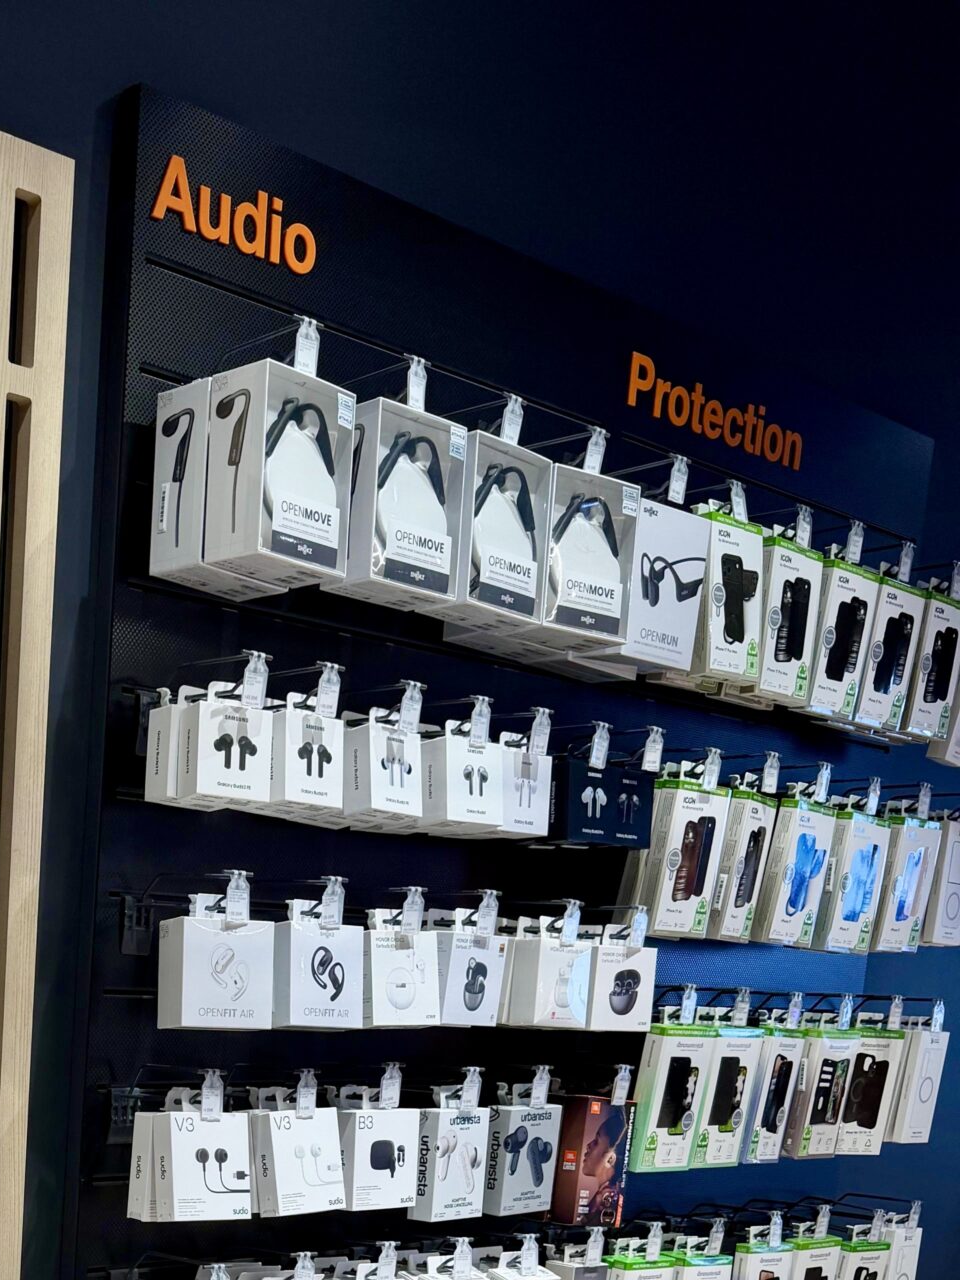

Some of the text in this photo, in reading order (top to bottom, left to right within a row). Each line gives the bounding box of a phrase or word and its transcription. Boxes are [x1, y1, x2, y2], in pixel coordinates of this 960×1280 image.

[151, 155, 316, 275] Audio
[628, 351, 803, 472] Protection
[281, 500, 332, 527] OPENMOVE
[395, 529, 444, 554] OPENMOVE
[488, 555, 532, 579] OPENMOVE
[566, 578, 615, 600] OPENMOVE
[640, 627, 679, 648] OPENRUN
[198, 1007, 255, 1019] OPENFIT AIR
[303, 1007, 349, 1018] OPENFIT AIR
[174, 1116, 195, 1132] V3
[273, 1115, 292, 1130] V3
[358, 1115, 374, 1130] B3
[450, 1115, 481, 1126] urbanista
[521, 1111, 552, 1122] urbanista
[417, 1135, 430, 1197] urbanista
[487, 1131, 501, 1191] urbanista
[328, 1196, 343, 1206] sudio
[232, 1207, 249, 1215] sudio
